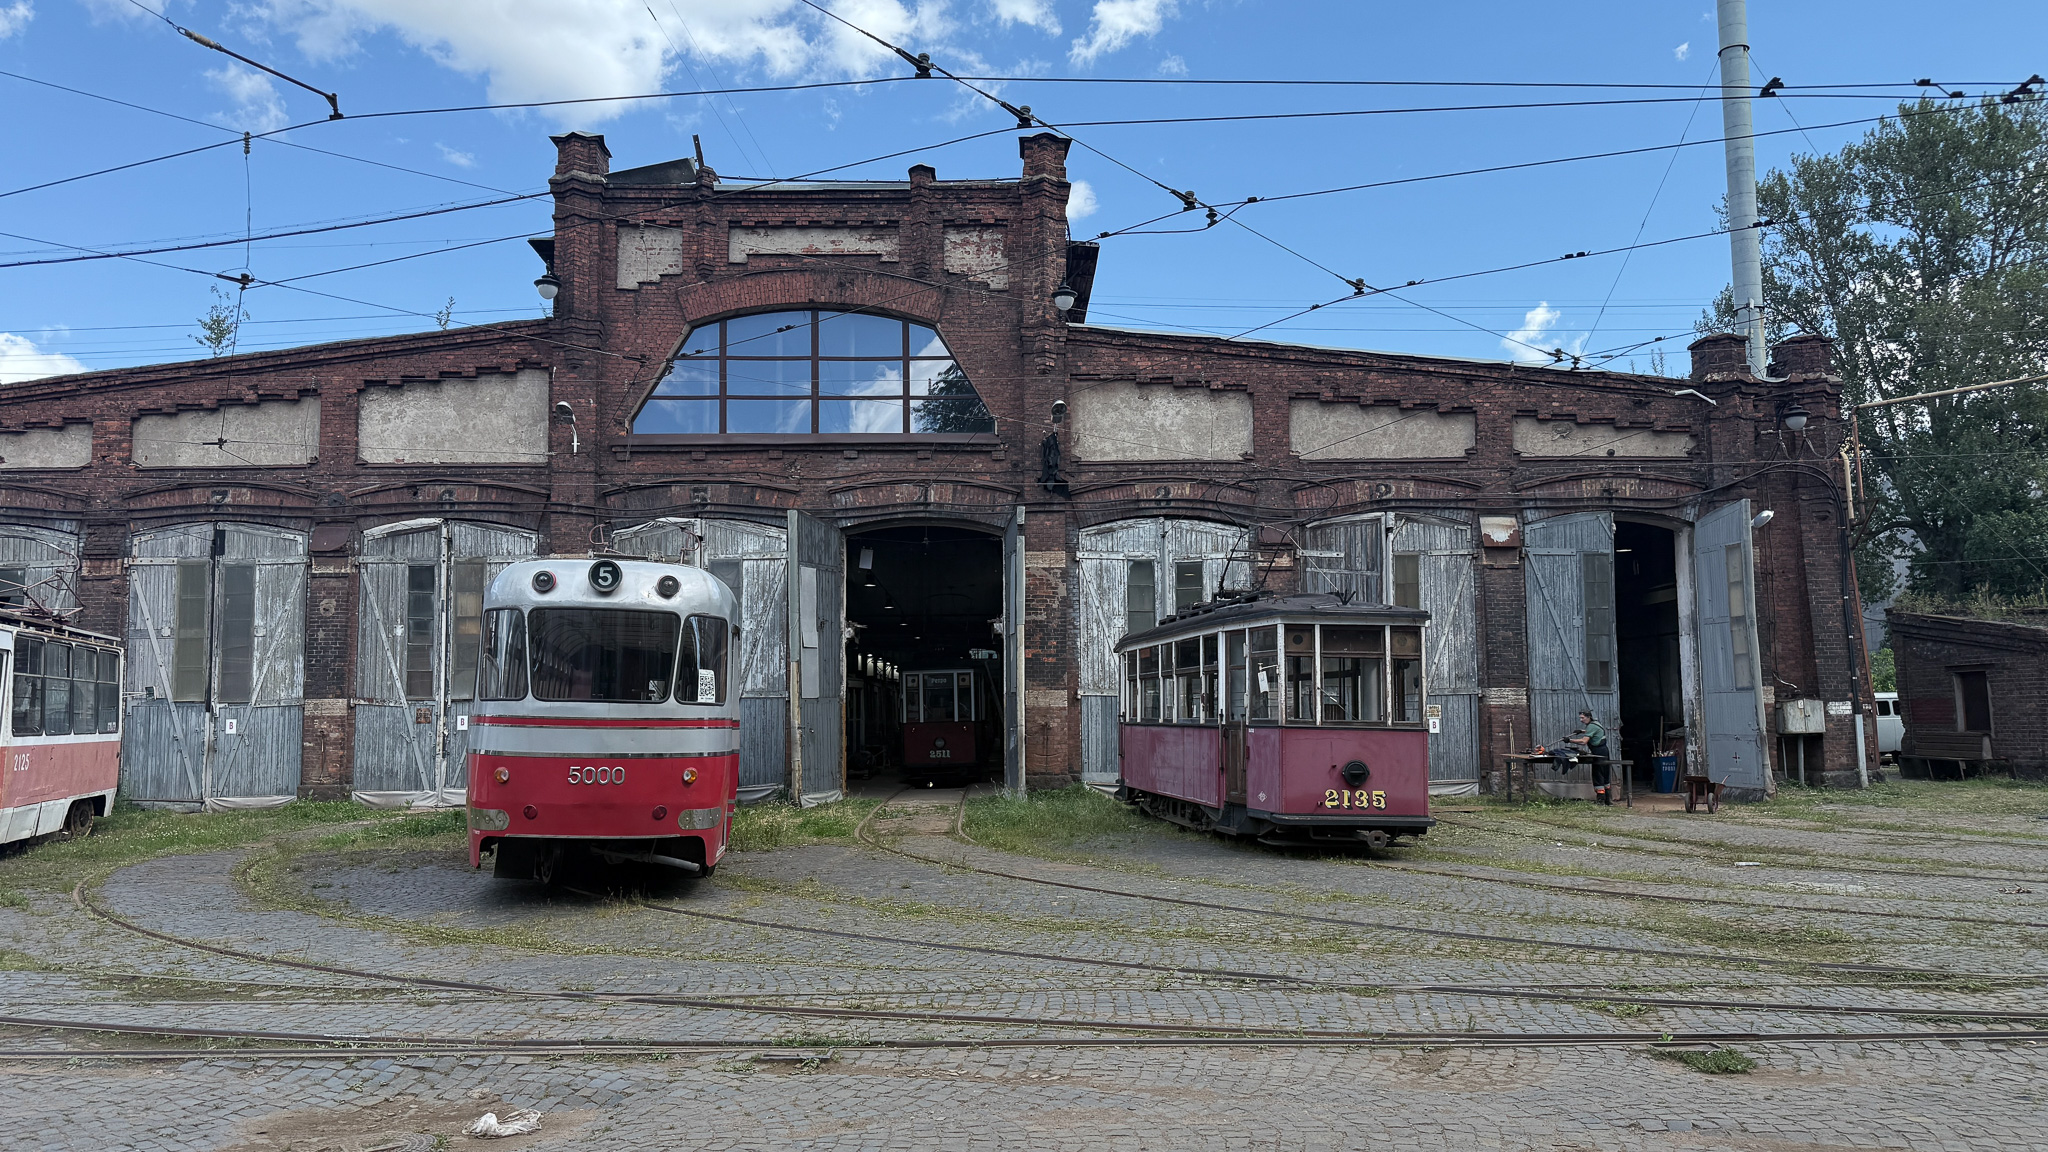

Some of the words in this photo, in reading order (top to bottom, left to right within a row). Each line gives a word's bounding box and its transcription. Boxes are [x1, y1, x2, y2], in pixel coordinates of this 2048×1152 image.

[598, 566, 613, 586] 5
[13, 753, 30, 772] 2125
[929, 749, 951, 758] 2511
[567, 766, 626, 785] 5000
[1324, 788, 1387, 811] 2135
